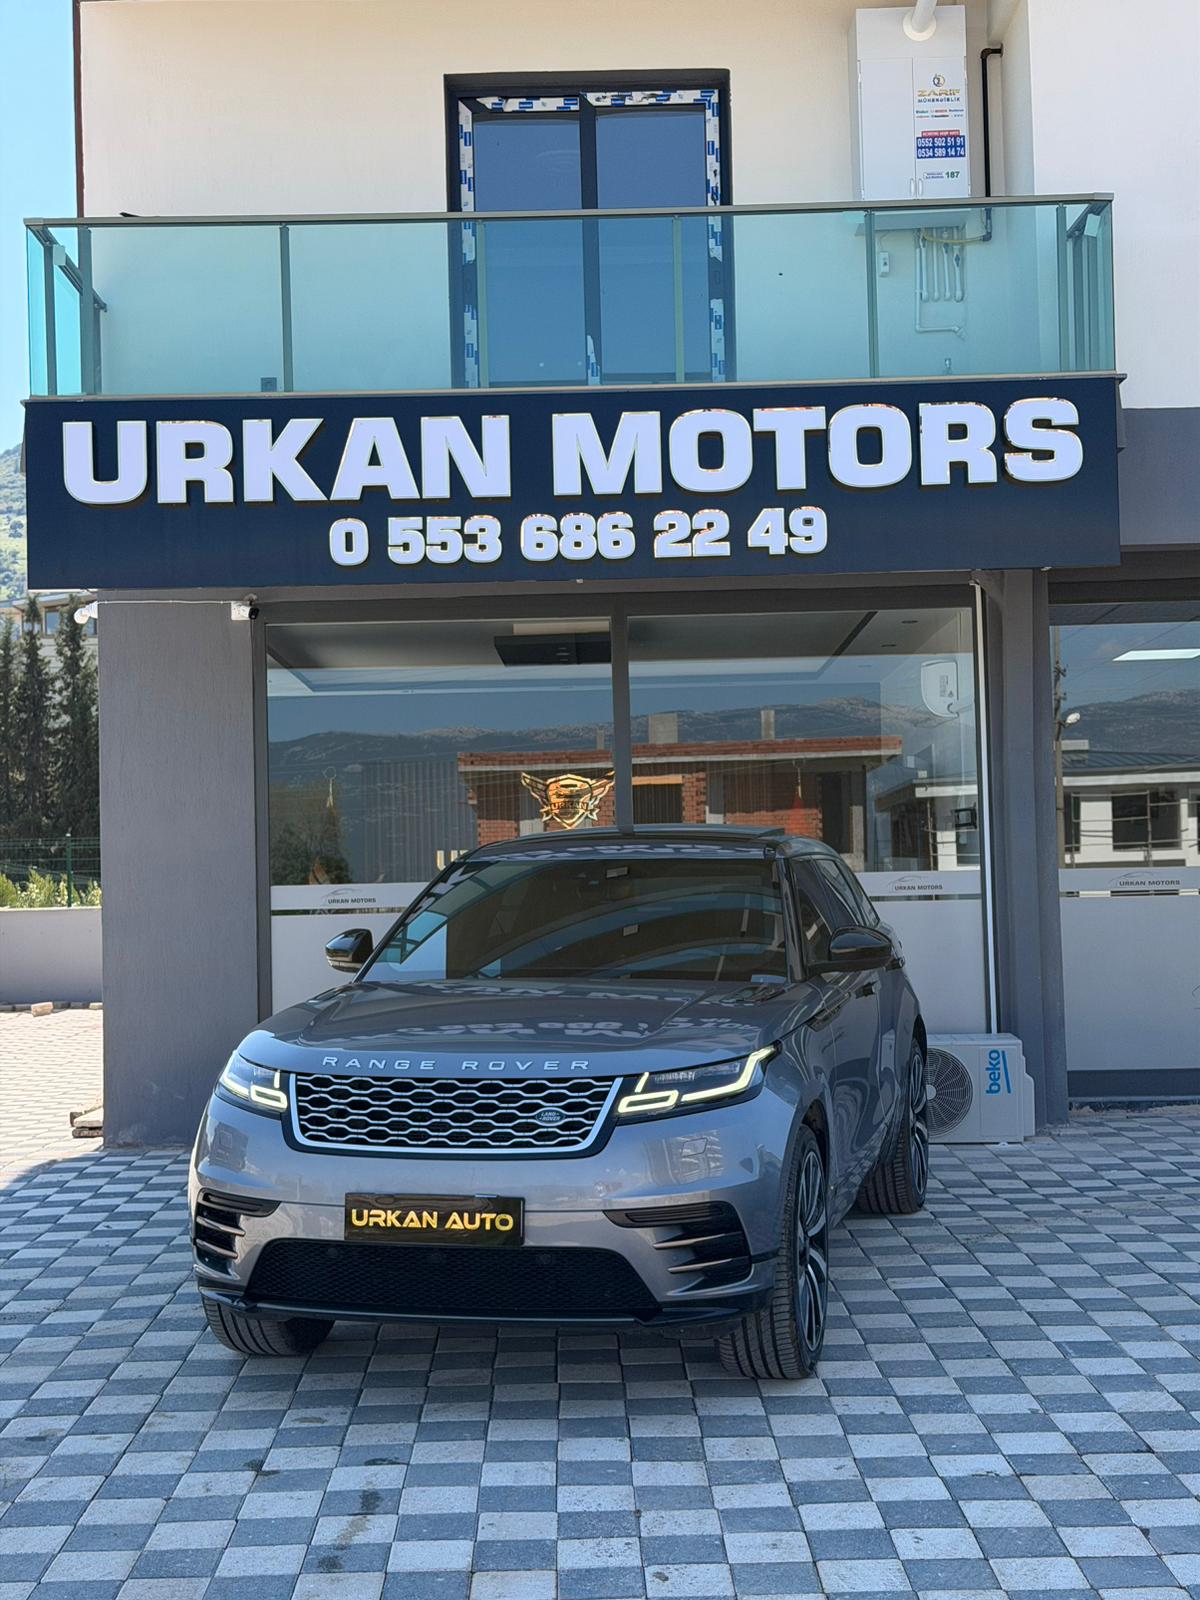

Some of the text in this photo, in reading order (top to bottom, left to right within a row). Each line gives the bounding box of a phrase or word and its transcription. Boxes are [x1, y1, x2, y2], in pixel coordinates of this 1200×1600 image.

[917, 136, 964, 147] 0552 502 51 91
[917, 148, 933, 157] 0534
[947, 147, 956, 156] 14
[956, 146, 965, 156] 74
[945, 171, 960, 179] 187
[63, 398, 1083, 504] URKAN MOTORS
[329, 507, 828, 566] 0 553 686 22 49
[322, 1056, 590, 1071] RANGE ROVER
[985, 1049, 1001, 1094] beko
[351, 1208, 514, 1232] URKAN AUTO
